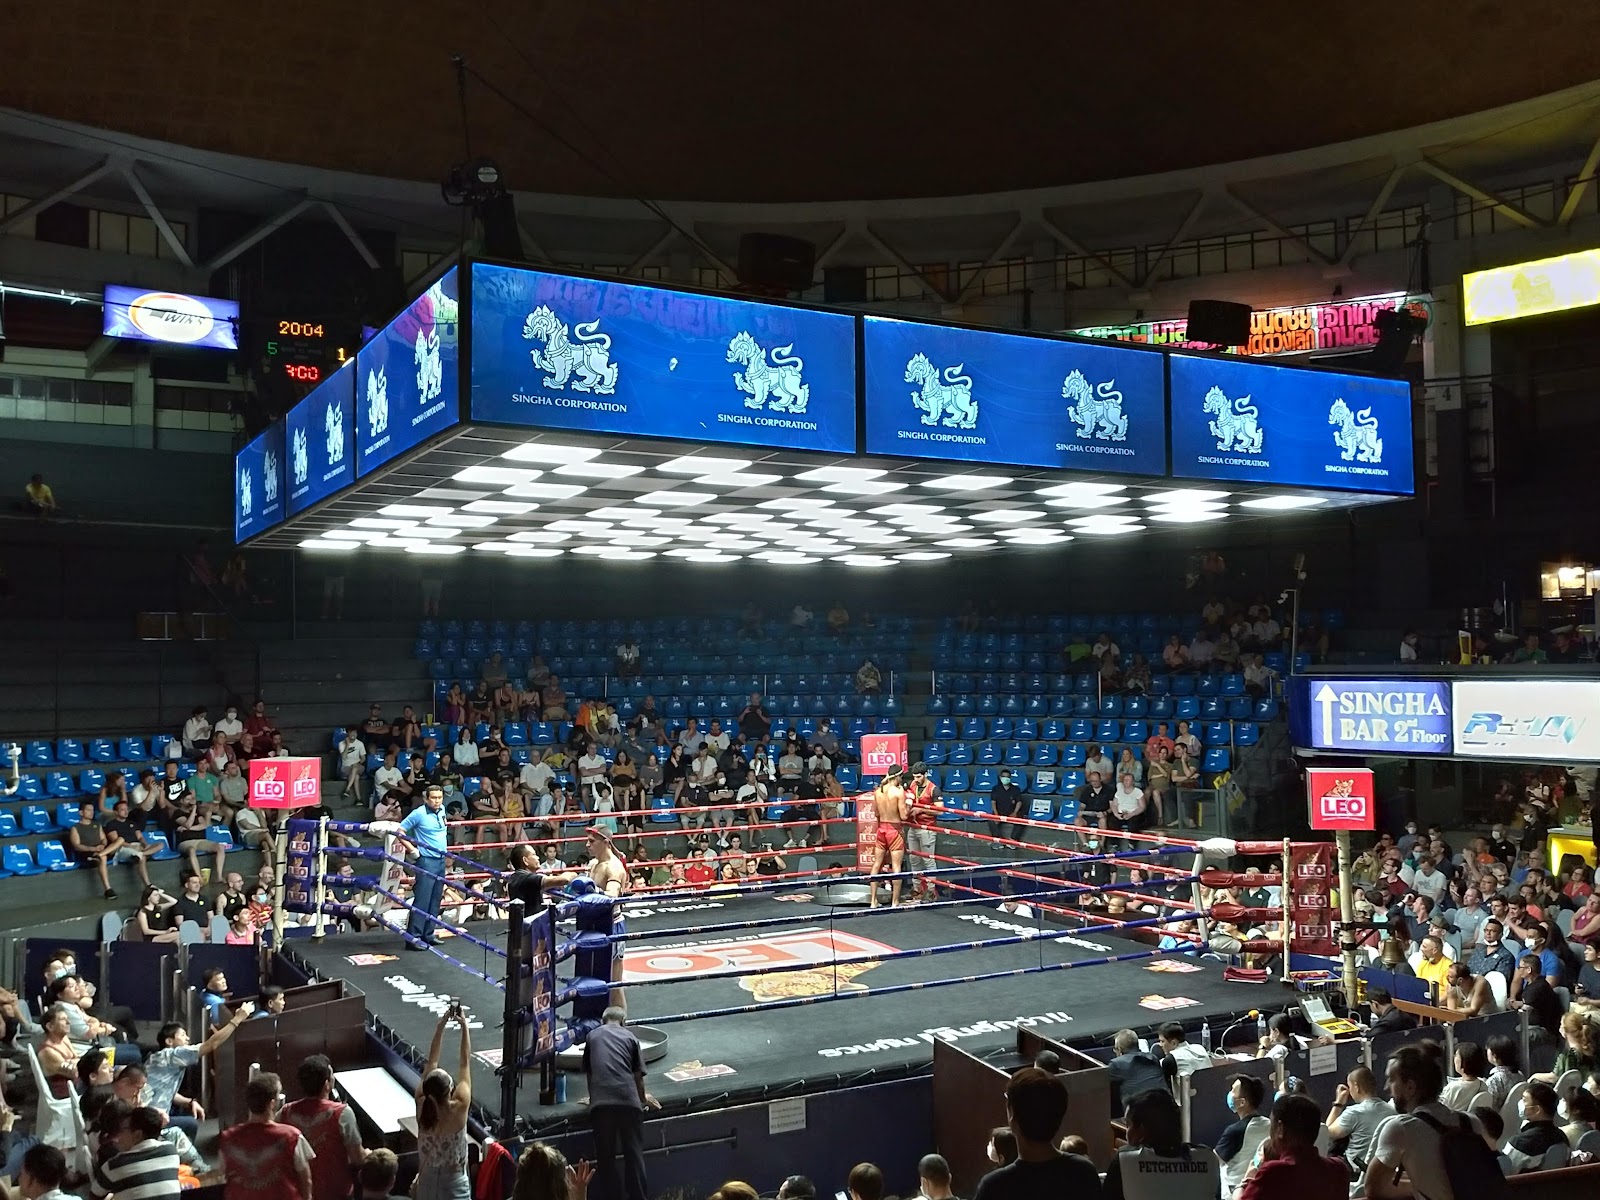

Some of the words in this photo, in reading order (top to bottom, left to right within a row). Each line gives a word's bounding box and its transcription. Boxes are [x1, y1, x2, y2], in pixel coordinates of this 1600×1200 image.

[267, 341, 278, 355] 5
[337, 347, 346, 361] 1
[512, 394, 552, 406] SINGHA
[555, 398, 627, 412] CORPORATION
[717, 414, 753, 424] SINGHA
[754, 417, 817, 430] CORPORATION
[897, 430, 928, 440] SINGHA
[930, 433, 986, 444] CORPORATION
[1056, 443, 1084, 452] SINGHA
[1085, 446, 1135, 456] CORPORATION
[1198, 456, 1223, 464] SINGHA
[1224, 457, 1270, 467] CORPORATION
[1325, 465, 1348, 473] SINGHA
[1348, 467, 1389, 476] CORPORATION
[1339, 691, 1446, 716] SINGHA
[1339, 718, 1390, 742] BAR
[1411, 729, 1447, 743] Floor
[870, 755, 894, 764] LEO
[257, 783, 283, 795] LEO
[296, 783, 315, 795] LEO
[1324, 799, 1363, 815] LEO
[290, 868, 307, 876] LEO
[1300, 866, 1325, 875] LEO
[289, 893, 306, 901] LEO
[1300, 897, 1326, 906] LEO
[1302, 927, 1327, 936] LEO
[623, 938, 867, 974] LEO
[534, 997, 549, 1010] LEO
[1138, 1161, 1209, 1173] PETCHYINDEE
